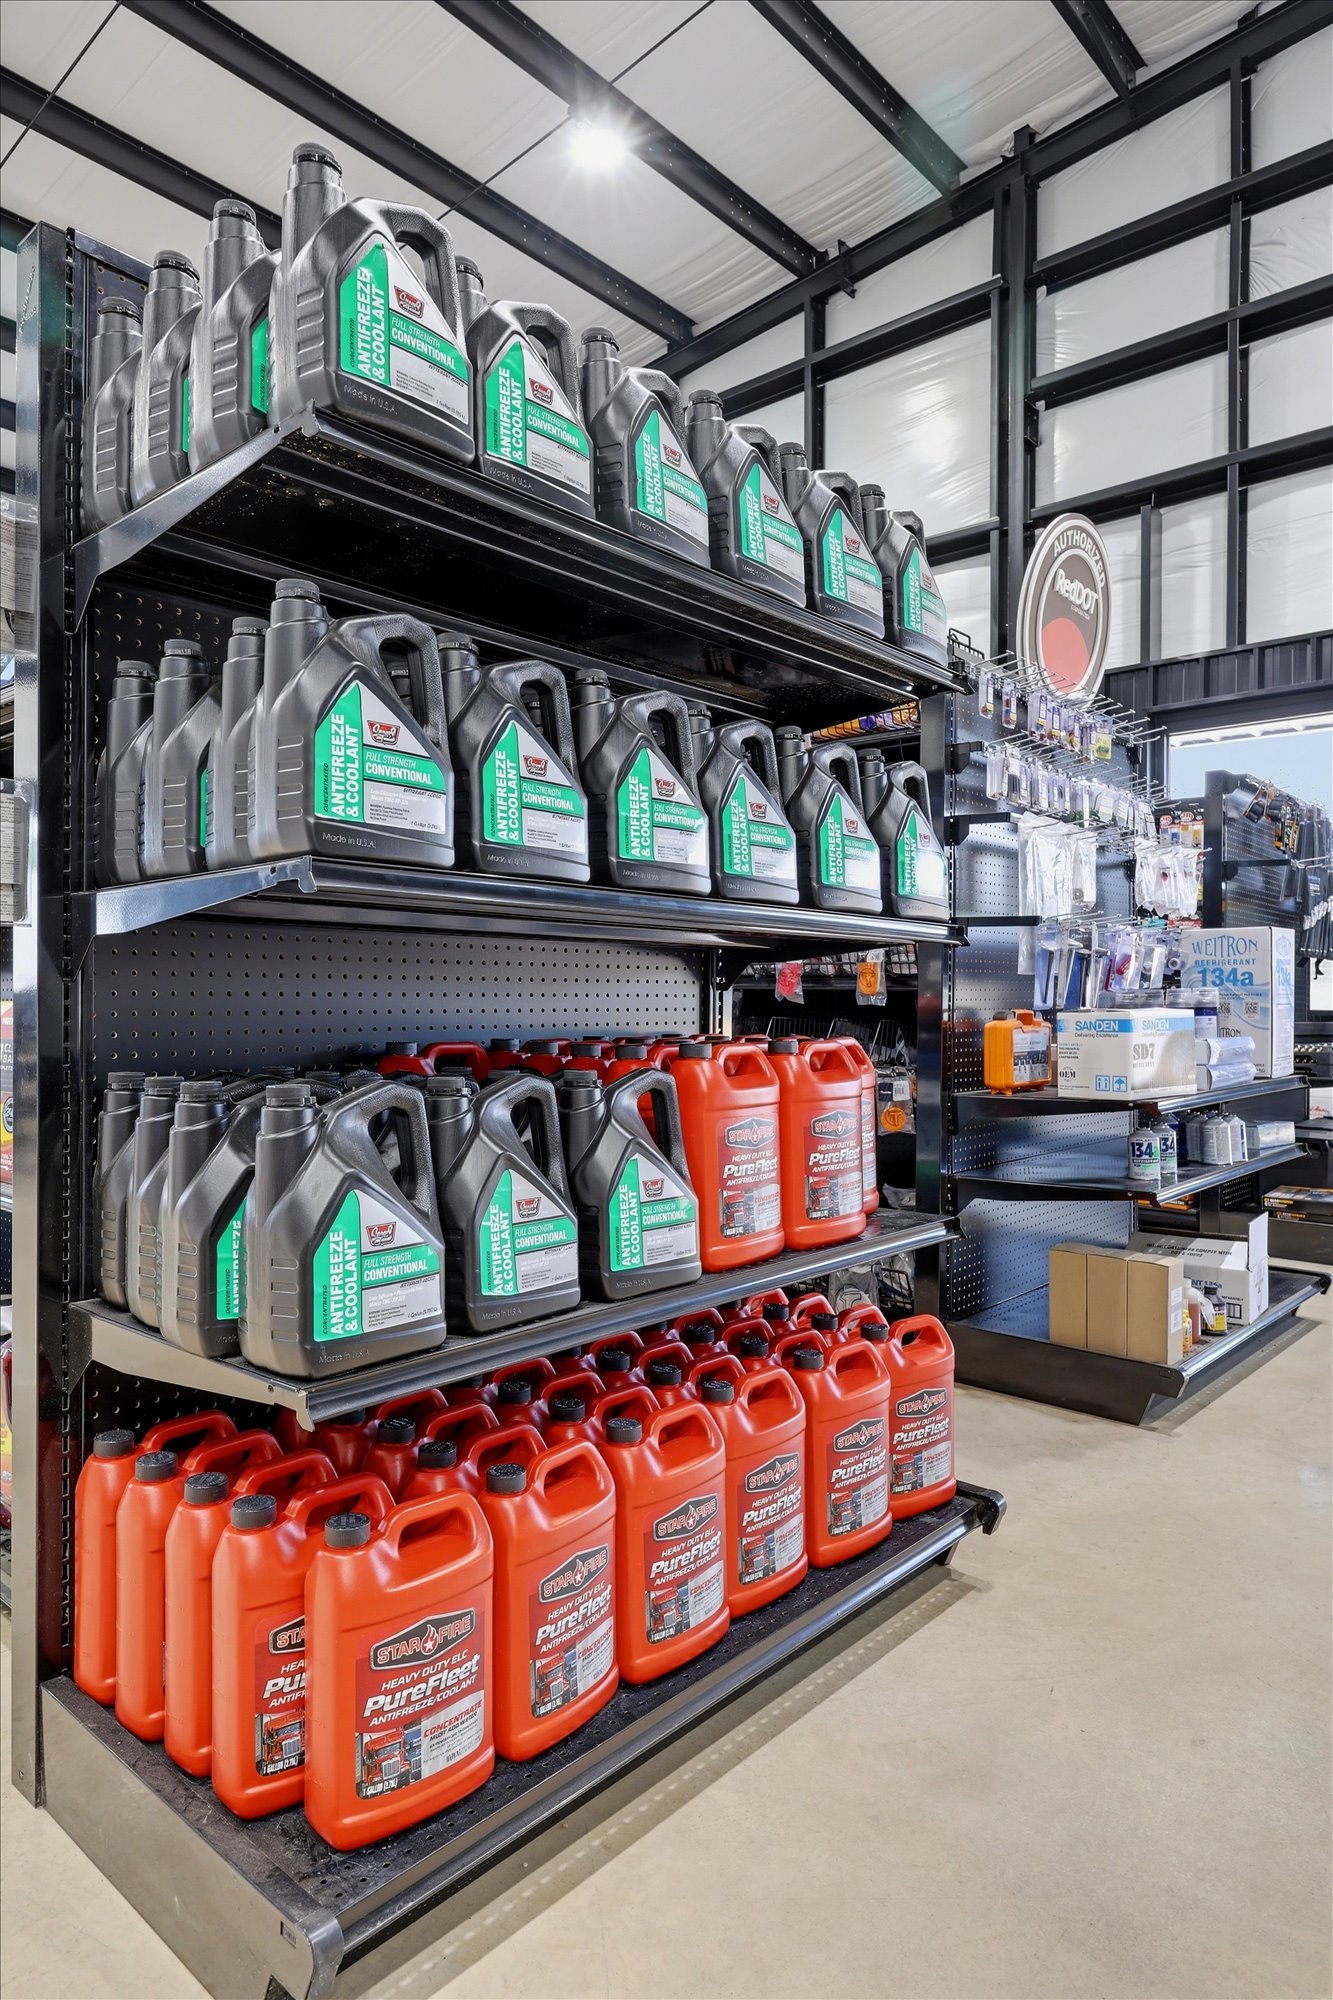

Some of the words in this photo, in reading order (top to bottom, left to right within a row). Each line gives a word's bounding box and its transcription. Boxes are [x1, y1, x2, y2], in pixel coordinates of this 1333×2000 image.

[357, 267, 371, 376] ANTIFREEZE
[372, 284, 384, 365] COOLANT
[392, 317, 406, 332] FULL
[408, 324, 440, 348] STRENGTH
[392, 328, 456, 370] CONVENTIONAL
[372, 366, 384, 380] &
[344, 384, 368, 401] Made
[499, 367, 511, 458] ANTIFREEZE
[511, 378, 522, 450] COOLANT
[527, 405, 540, 417] FULL
[528, 416, 579, 448] CONVENTIONAL
[513, 452, 522, 460] &
[643, 432, 654, 513] ANTIFREEZE
[651, 443, 662, 506] COOLANT
[655, 506, 663, 516] &
[746, 485, 757, 558] ANTIFREEZE
[753, 497, 763, 551] COOLANT
[829, 529, 839, 596] ANTIFREEZE
[835, 537, 845, 589] COOLANT
[1054, 530, 1105, 589] AUTHORIZED
[1056, 569, 1098, 614] RedDOT
[331, 714, 345, 816] ANTIFREEZE
[346, 725, 359, 803] COOLANT
[366, 752, 381, 763] FULL
[383, 755, 416, 767] STRENGTH
[366, 763, 432, 784] CONVENTIONAL
[496, 750, 507, 840] ANTIFREEZE
[507, 760, 518, 829] COOLANT
[523, 783, 534, 792] FULL
[536, 786, 561, 797] STRENGTH
[523, 793, 574, 810] CONVENTIONAL
[346, 804, 359, 817] &
[629, 776, 640, 857] ANTIFREEZE
[639, 784, 650, 846] COOLANT
[323, 833, 346, 843] Made
[509, 830, 518, 840] &
[731, 799, 741, 872] ANTIFREEZE
[739, 806, 748, 863] COOLANT
[828, 816, 836, 882] ANTIFREEZE
[835, 822, 843, 874] COOLANT
[641, 847, 650, 857] &
[742, 864, 748, 872] &
[1192, 935, 1258, 958] WEITRON
[1198, 968, 1254, 987] 134a
[1075, 1020, 1118, 1031] SANDEN
[1142, 1020, 1169, 1030] SANDEN
[1133, 1043, 1155, 1060] SD7
[723, 1157, 778, 1178] PureFleet
[809, 1147, 860, 1166] PureFleet
[620, 1184, 630, 1266] ANTIFREEZE
[629, 1190, 639, 1253] COOLANT
[643, 1206, 653, 1214] FULL
[654, 1203, 675, 1212] STRENGTH
[643, 1209, 687, 1225] CONVENTIONAL
[500, 1211, 513, 1280] COOLANT
[515, 1227, 527, 1236] FULL
[528, 1224, 553, 1233] STRENGTH
[516, 1230, 567, 1248] CONVENTIONAL
[364, 1258, 379, 1268] FULL
[381, 1252, 412, 1265] STRENGTH
[490, 1204, 503, 1294] ANTIFREEZE
[631, 1254, 640, 1264] &
[330, 1231, 343, 1334] ANTIFREEZE
[345, 1239, 357, 1318] COOLANT
[364, 1259, 427, 1282] CONVENTIONAL
[504, 1281, 514, 1291] &
[345, 1320, 357, 1331] &
[899, 1400, 922, 1414] STAR
[902, 1421, 921, 1430] HEAVY
[922, 1416, 936, 1425] DUTY
[837, 1432, 861, 1449] STAR
[893, 1418, 949, 1445] PureFleet
[832, 1449, 886, 1482] PureFleet
[840, 1454, 859, 1466] HEAVY
[860, 1449, 874, 1460] DUTY
[749, 1470, 773, 1488] STAR
[742, 1487, 801, 1526] PureFleet
[752, 1494, 773, 1508] HEAVY
[774, 1488, 788, 1499] DUTY
[658, 1514, 686, 1536] STAR
[696, 1499, 716, 1521] FIRE
[650, 1531, 721, 1578] PureFleet
[662, 1544, 686, 1558] HEAVY
[687, 1534, 704, 1546] DUTY
[705, 1526, 715, 1537] ELC
[544, 1575, 573, 1597] STAR
[585, 1550, 606, 1575] FIRE
[654, 1548, 720, 1586] ANTIFREEZE/COOLANT
[535, 1585, 612, 1645] PureFleet
[548, 1600, 573, 1621] HEAVY
[574, 1590, 593, 1606] DUTY
[594, 1581, 605, 1593] ELC
[277, 1626, 305, 1648] STA
[377, 1637, 420, 1664] STAR
[438, 1615, 471, 1643] FIRE
[540, 1604, 610, 1654] ANTIFREEZE/COOLANT
[364, 1654, 480, 1717] PureFleet
[381, 1670, 420, 1691] HEAVY
[422, 1659, 451, 1675] DUTY
[452, 1650, 468, 1664] ELC
[369, 1674, 477, 1727] ANTIFREEZE/COOLANT
[424, 1700, 483, 1738] CONCENTRATE
[430, 1731, 447, 1741] MUST
[448, 1723, 459, 1733] ADD
[460, 1711, 477, 1725] WATER
